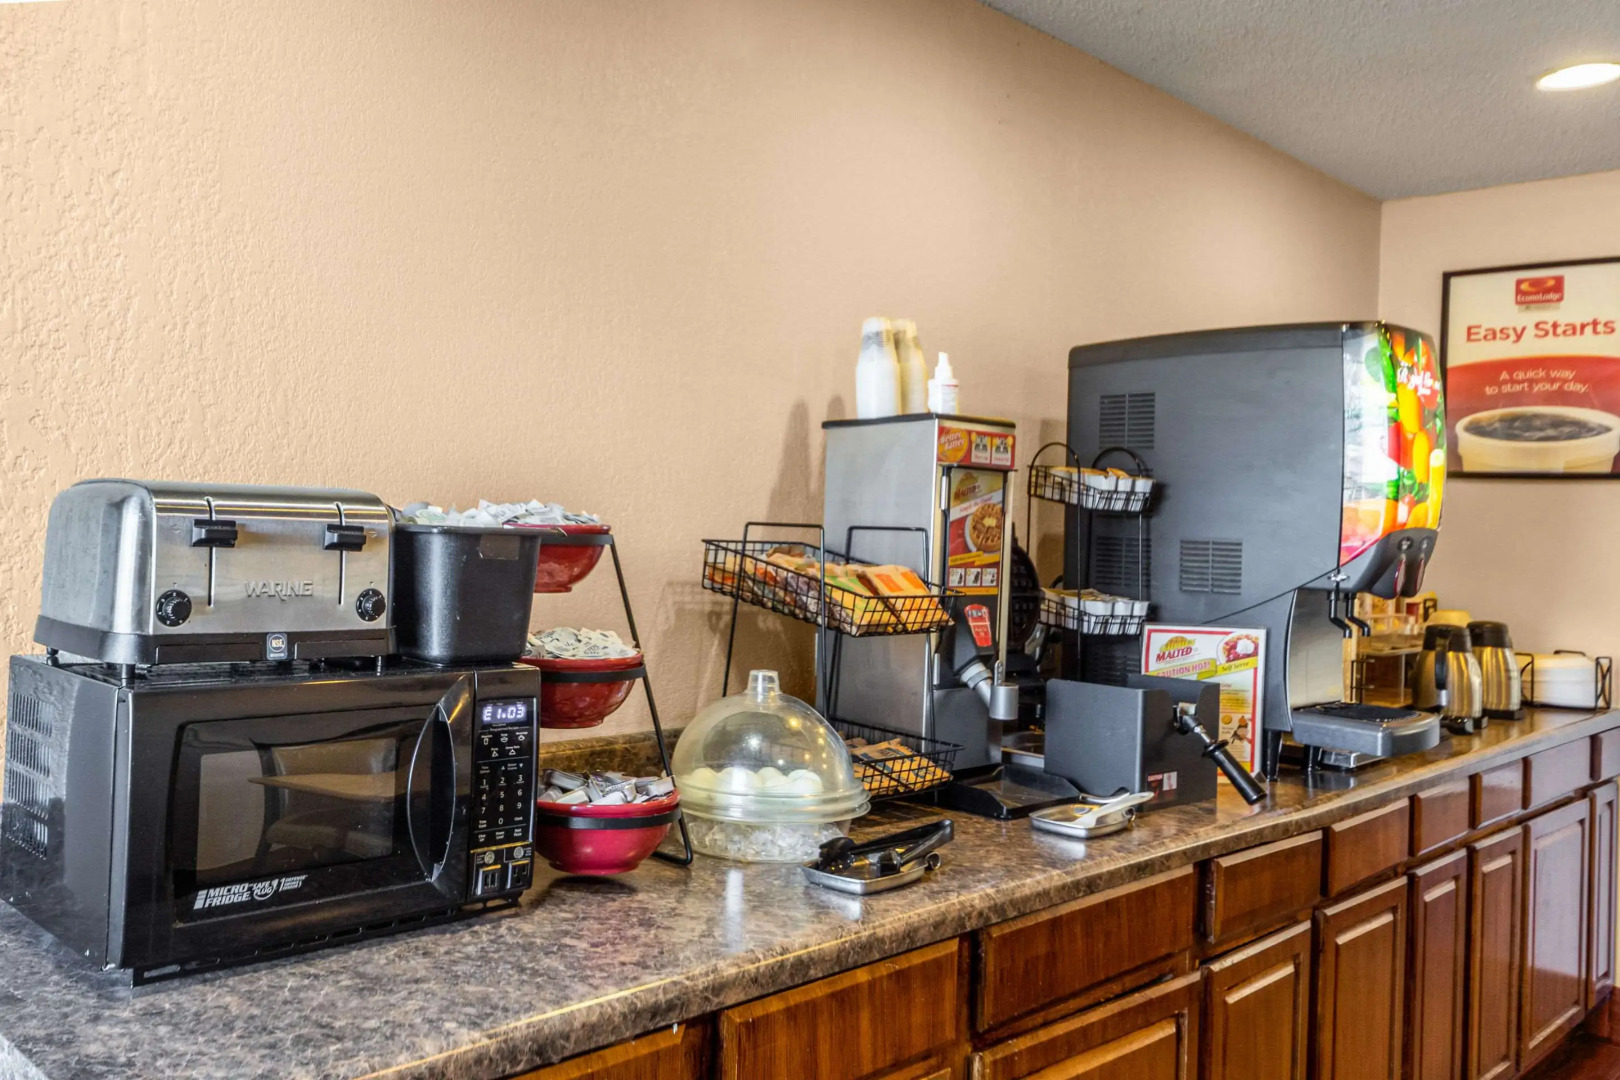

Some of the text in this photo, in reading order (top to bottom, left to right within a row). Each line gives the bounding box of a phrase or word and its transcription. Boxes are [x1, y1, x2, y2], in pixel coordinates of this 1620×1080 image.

[1466, 317, 1616, 344] Easy Starts
[1499, 368, 1577, 381] A quick way
[1485, 380, 1590, 395] to start your day.
[243, 580, 314, 602] WARING
[1155, 647, 1193, 663] MALTED
[500, 776, 505, 784] 2
[518, 774, 523, 782] 3
[517, 788, 523, 796] 6
[481, 806, 486, 814] 7
[517, 801, 522, 809] 9
[207, 883, 249, 898] MICRO
[256, 887, 273, 897] PLUG
[204, 891, 250, 908] FRIDGE
